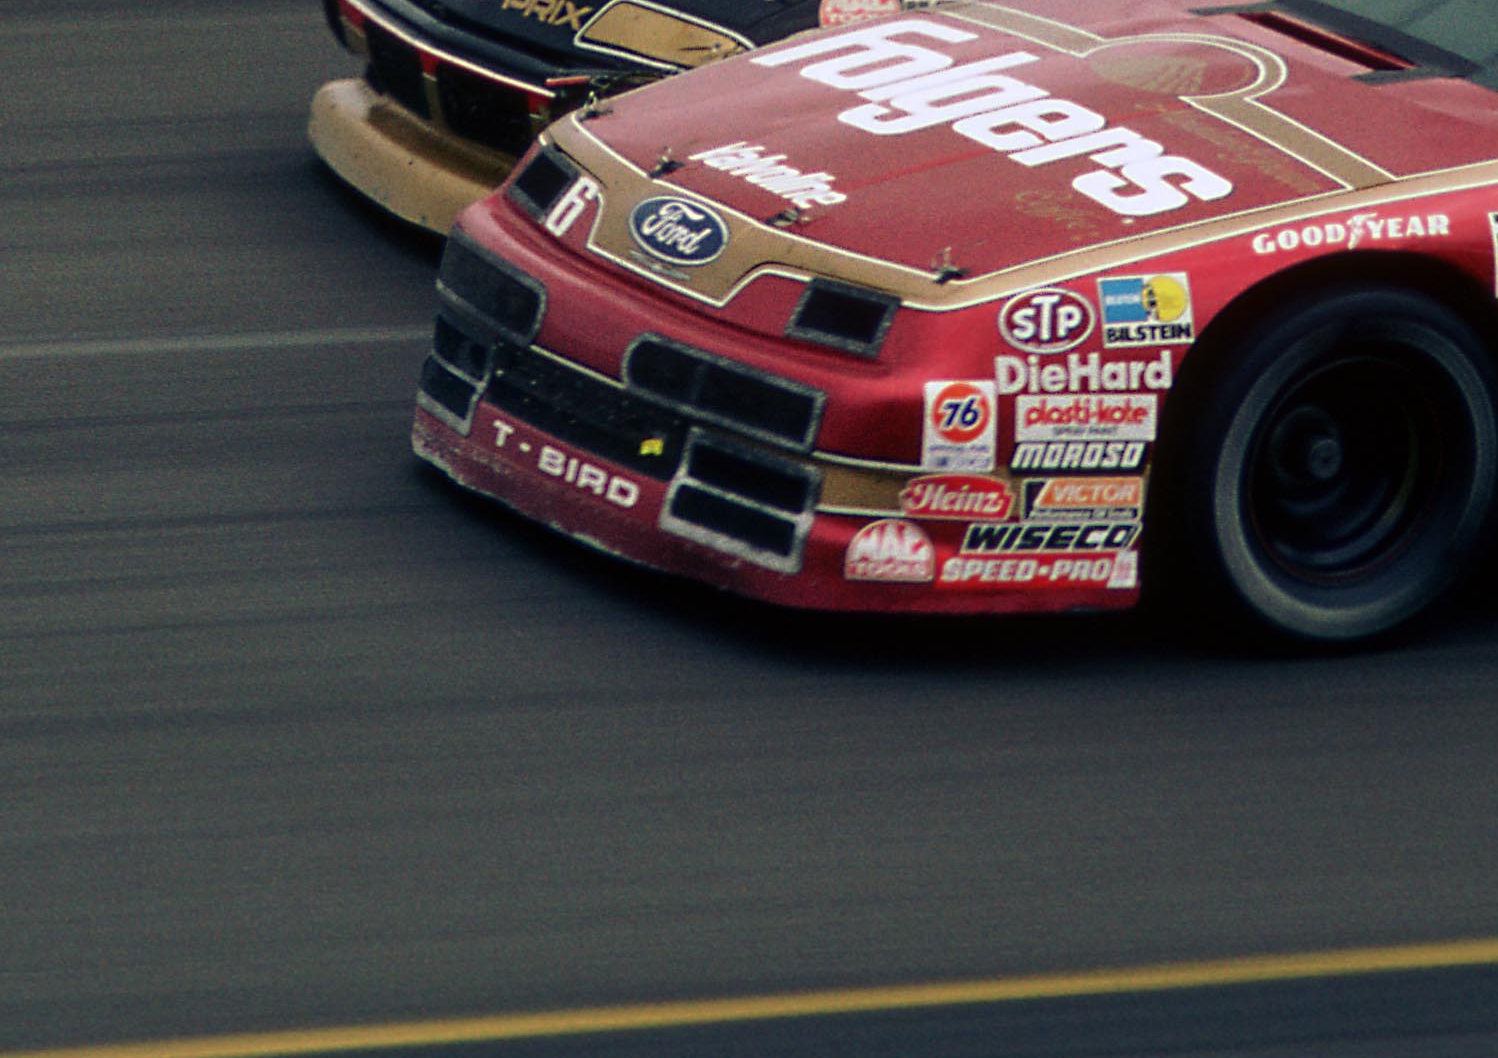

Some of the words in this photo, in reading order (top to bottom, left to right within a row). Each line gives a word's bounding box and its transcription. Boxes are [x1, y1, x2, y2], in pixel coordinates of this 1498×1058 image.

[749, 18, 1234, 216] Folgers
[546, 175, 600, 237] 6
[640, 200, 714, 255] Ford
[1252, 212, 1450, 254] GOODYEAR
[1010, 294, 1083, 342] STP
[1105, 322, 1193, 343] BILSTEIN
[994, 348, 1173, 396] DieHard
[941, 397, 979, 428] 76
[1024, 397, 1149, 427] plasti-kote
[1010, 442, 1146, 470] MOROSO
[907, 481, 1005, 515] Heinz
[1053, 484, 1136, 502] VICTOR
[851, 522, 931, 561] MAC
[961, 522, 1142, 553] WISECO
[939, 557, 1116, 583] SPEED-PRO
